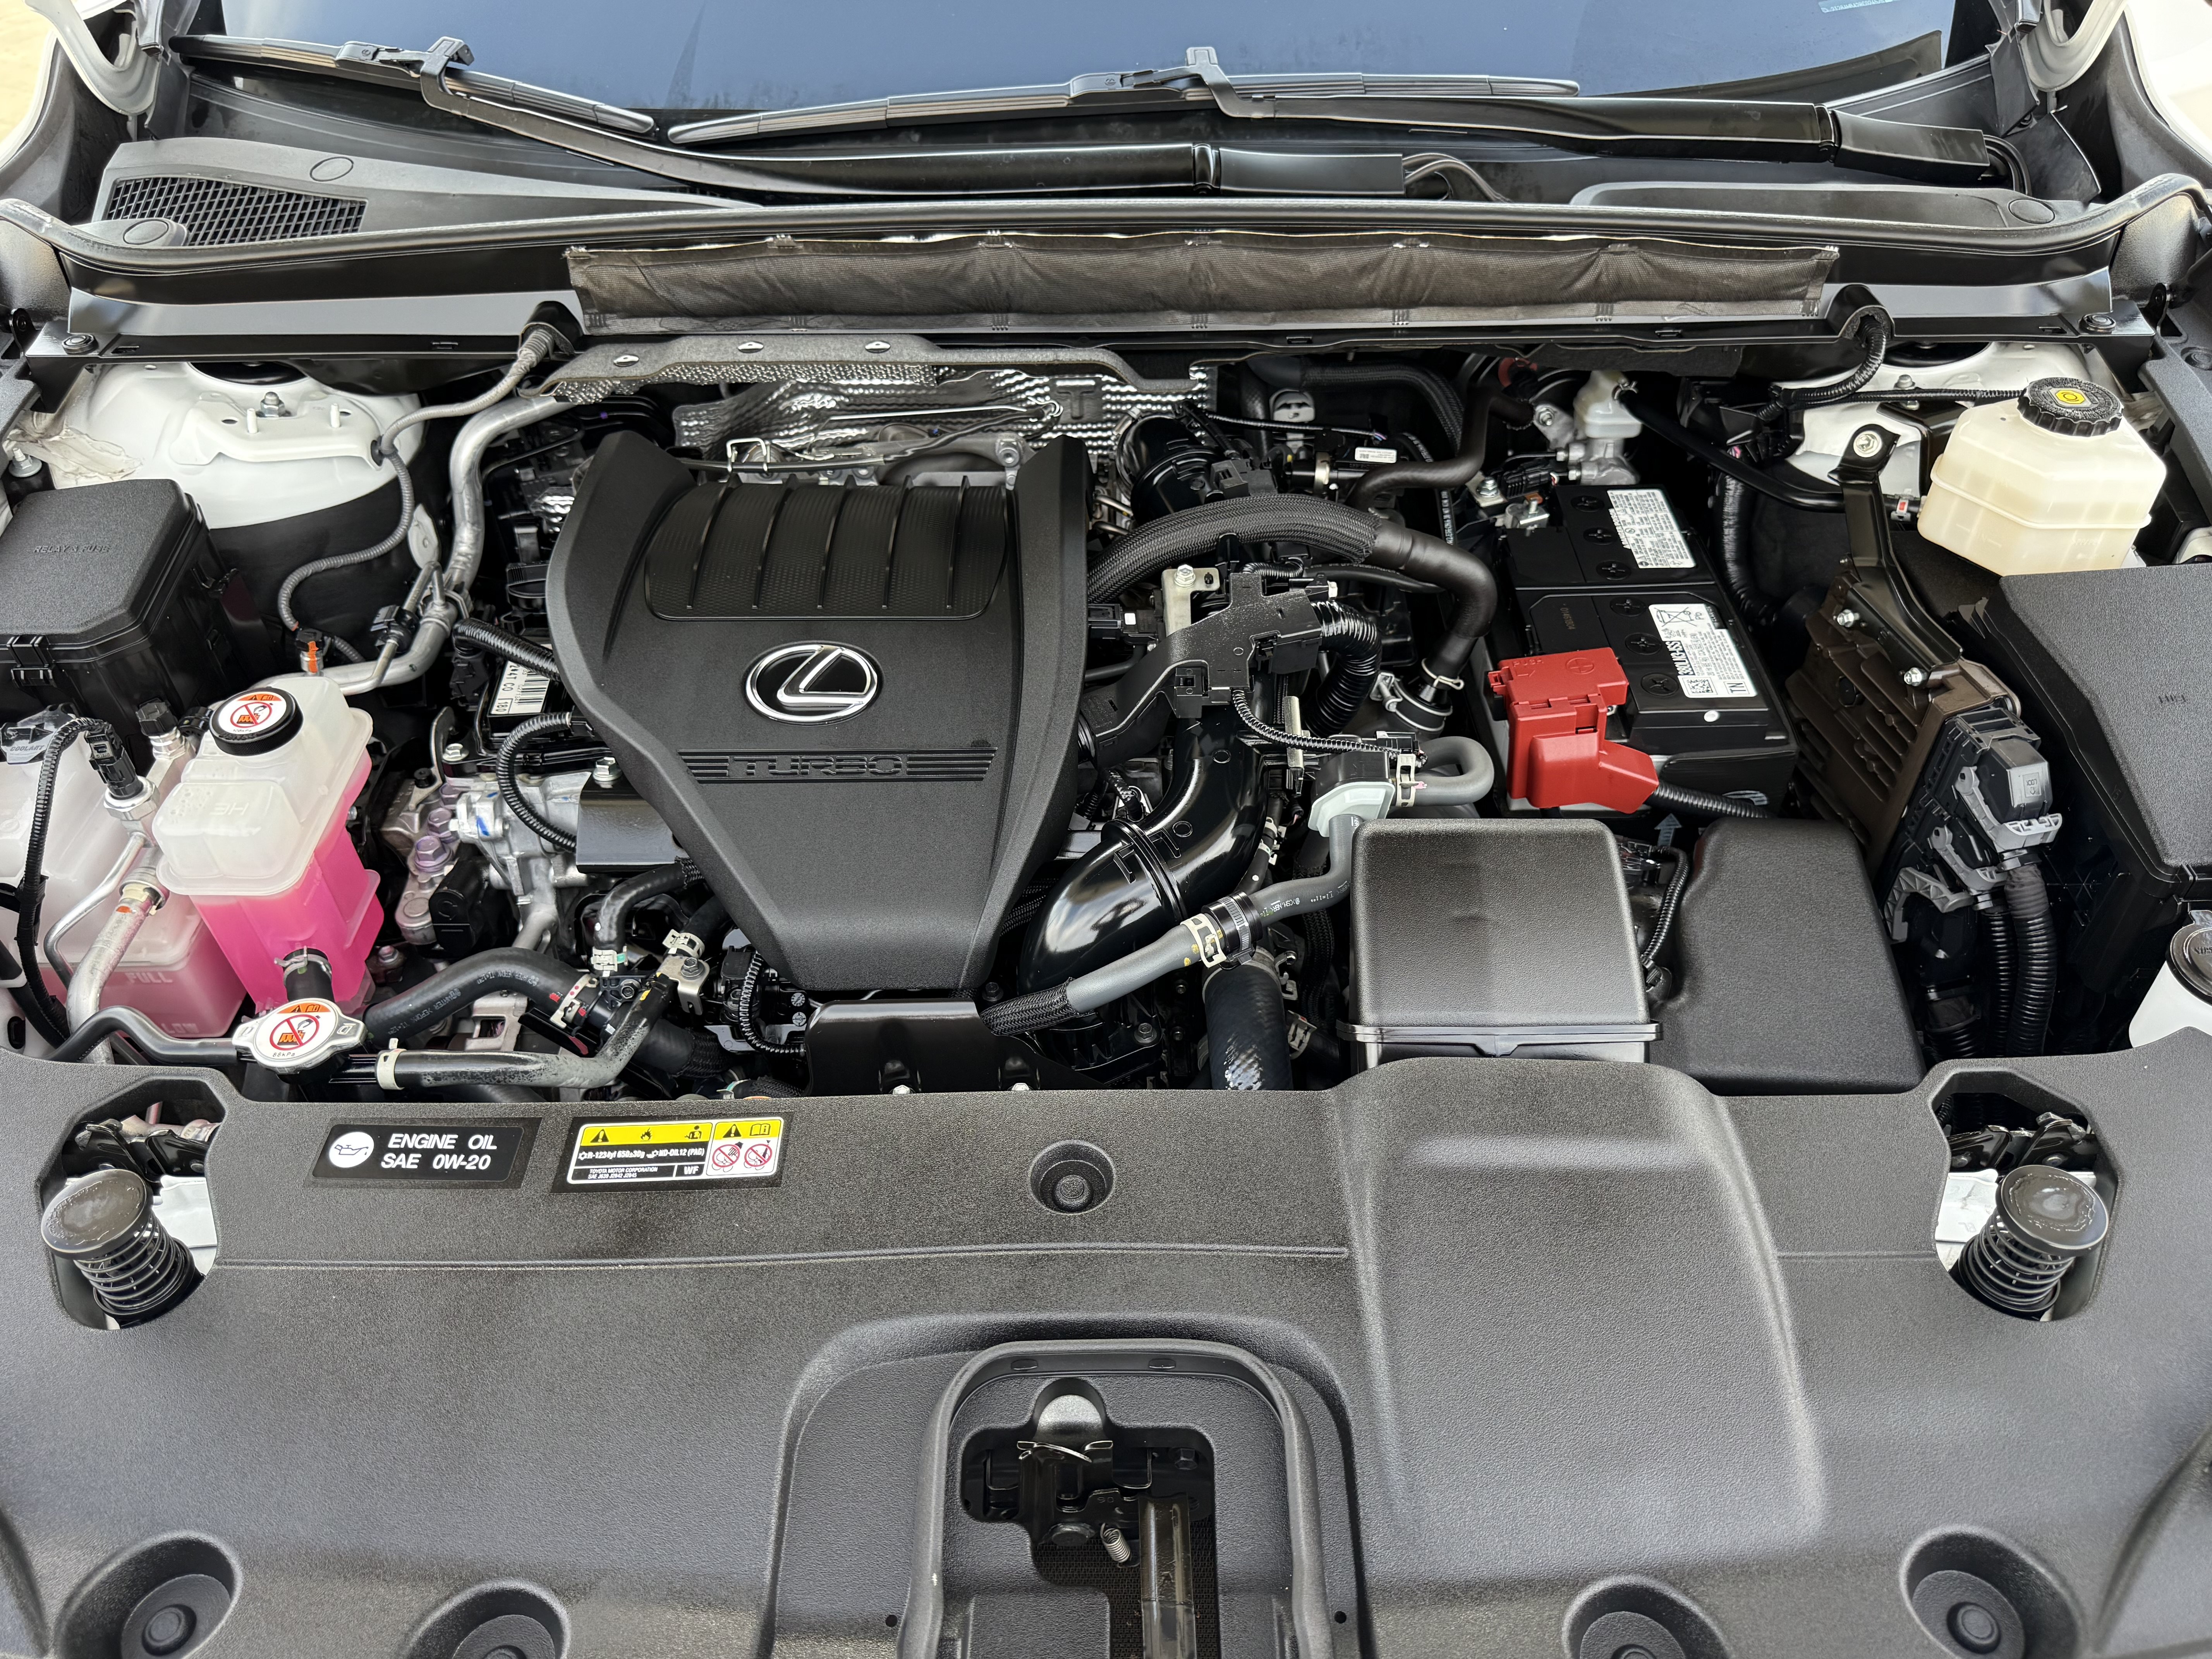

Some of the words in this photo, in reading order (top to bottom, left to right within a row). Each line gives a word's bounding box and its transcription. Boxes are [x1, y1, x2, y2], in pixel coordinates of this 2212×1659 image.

[33, 544, 70, 553] RELAY
[82, 544, 111, 553] FUSE
[1511, 657, 1544, 667] PUSH
[1726, 682, 1747, 693] TN
[496, 702, 509, 713] 180
[10, 744, 45, 752] COOLANT
[732, 754, 903, 776] TURBO
[124, 972, 173, 984] FULL
[162, 1021, 199, 1035] LOW
[388, 1133, 459, 1150] ENGINE
[468, 1133, 497, 1150] OIL
[687, 1148, 705, 1157] (PAG)
[380, 1153, 420, 1170] SAE
[433, 1153, 491, 1170] 0W-20
[684, 1166, 699, 1175] WF
